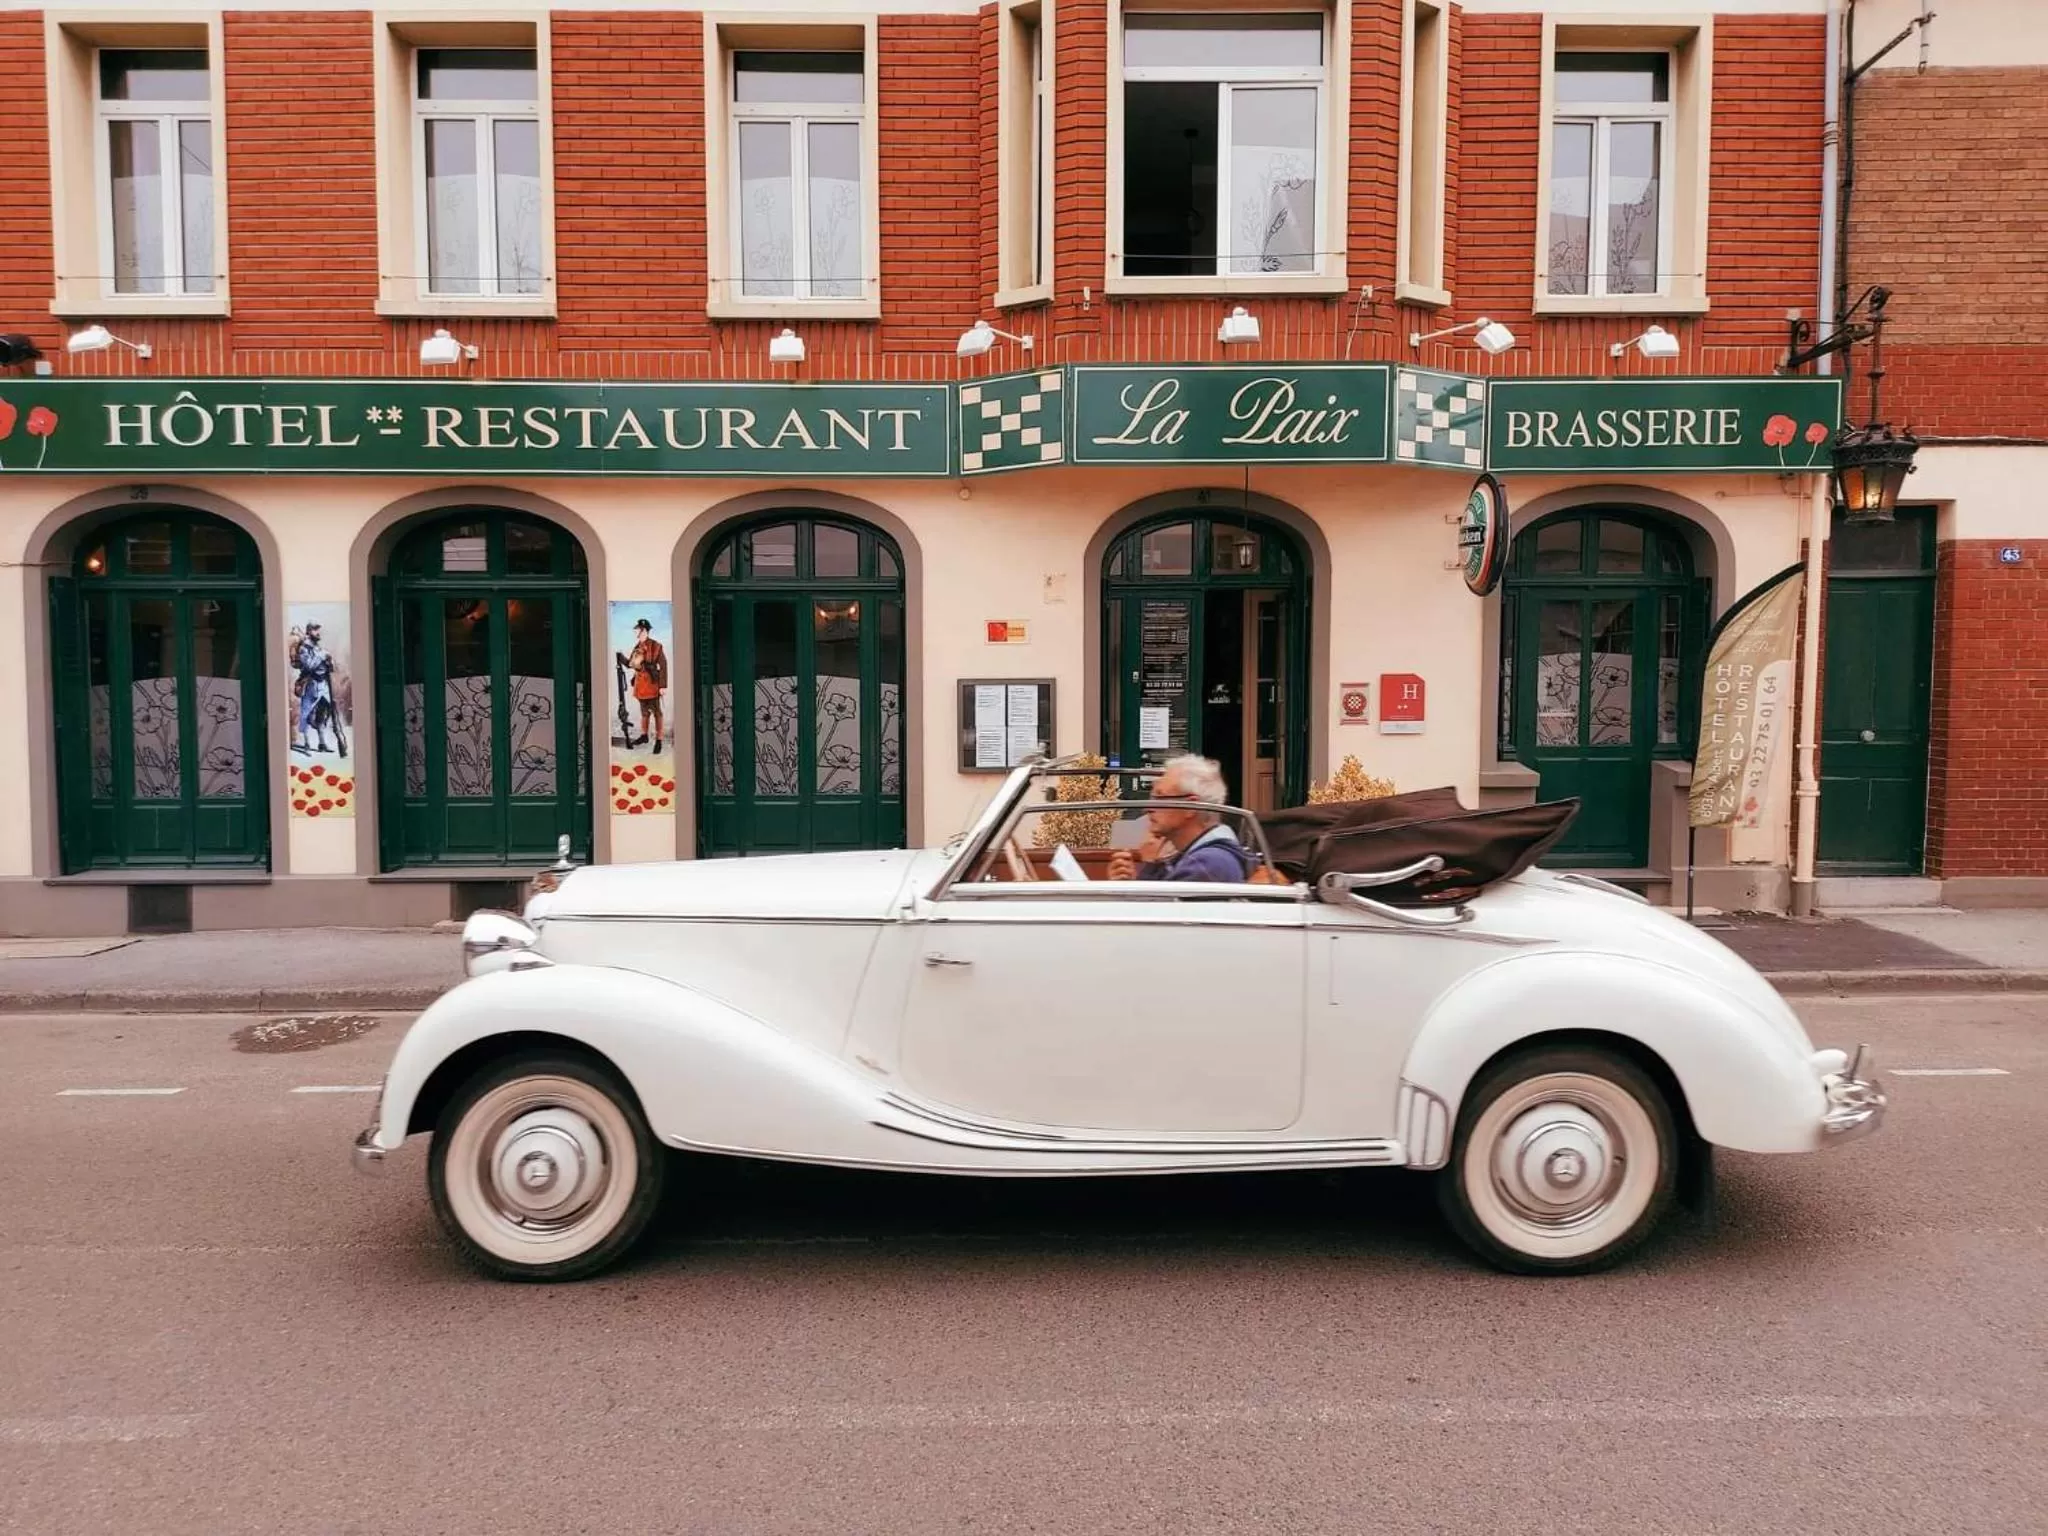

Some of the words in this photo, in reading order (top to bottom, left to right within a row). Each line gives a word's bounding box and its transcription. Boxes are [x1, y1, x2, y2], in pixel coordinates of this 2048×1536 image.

[104, 391, 361, 446] HÔTEL
[420, 404, 922, 450] RESTAURANT
[1092, 378, 1190, 445] La
[1222, 377, 1359, 444] Paix
[1506, 408, 1742, 447] BRASSERIE
[1402, 683, 1418, 700] H
[1763, 676, 1777, 694] 64
[1711, 664, 1732, 743] HÔTEL
[1760, 702, 1776, 718] 01
[1718, 664, 1754, 822] RESTAURANT
[1752, 745, 1768, 764] 22
[1749, 771, 1763, 788] 03
